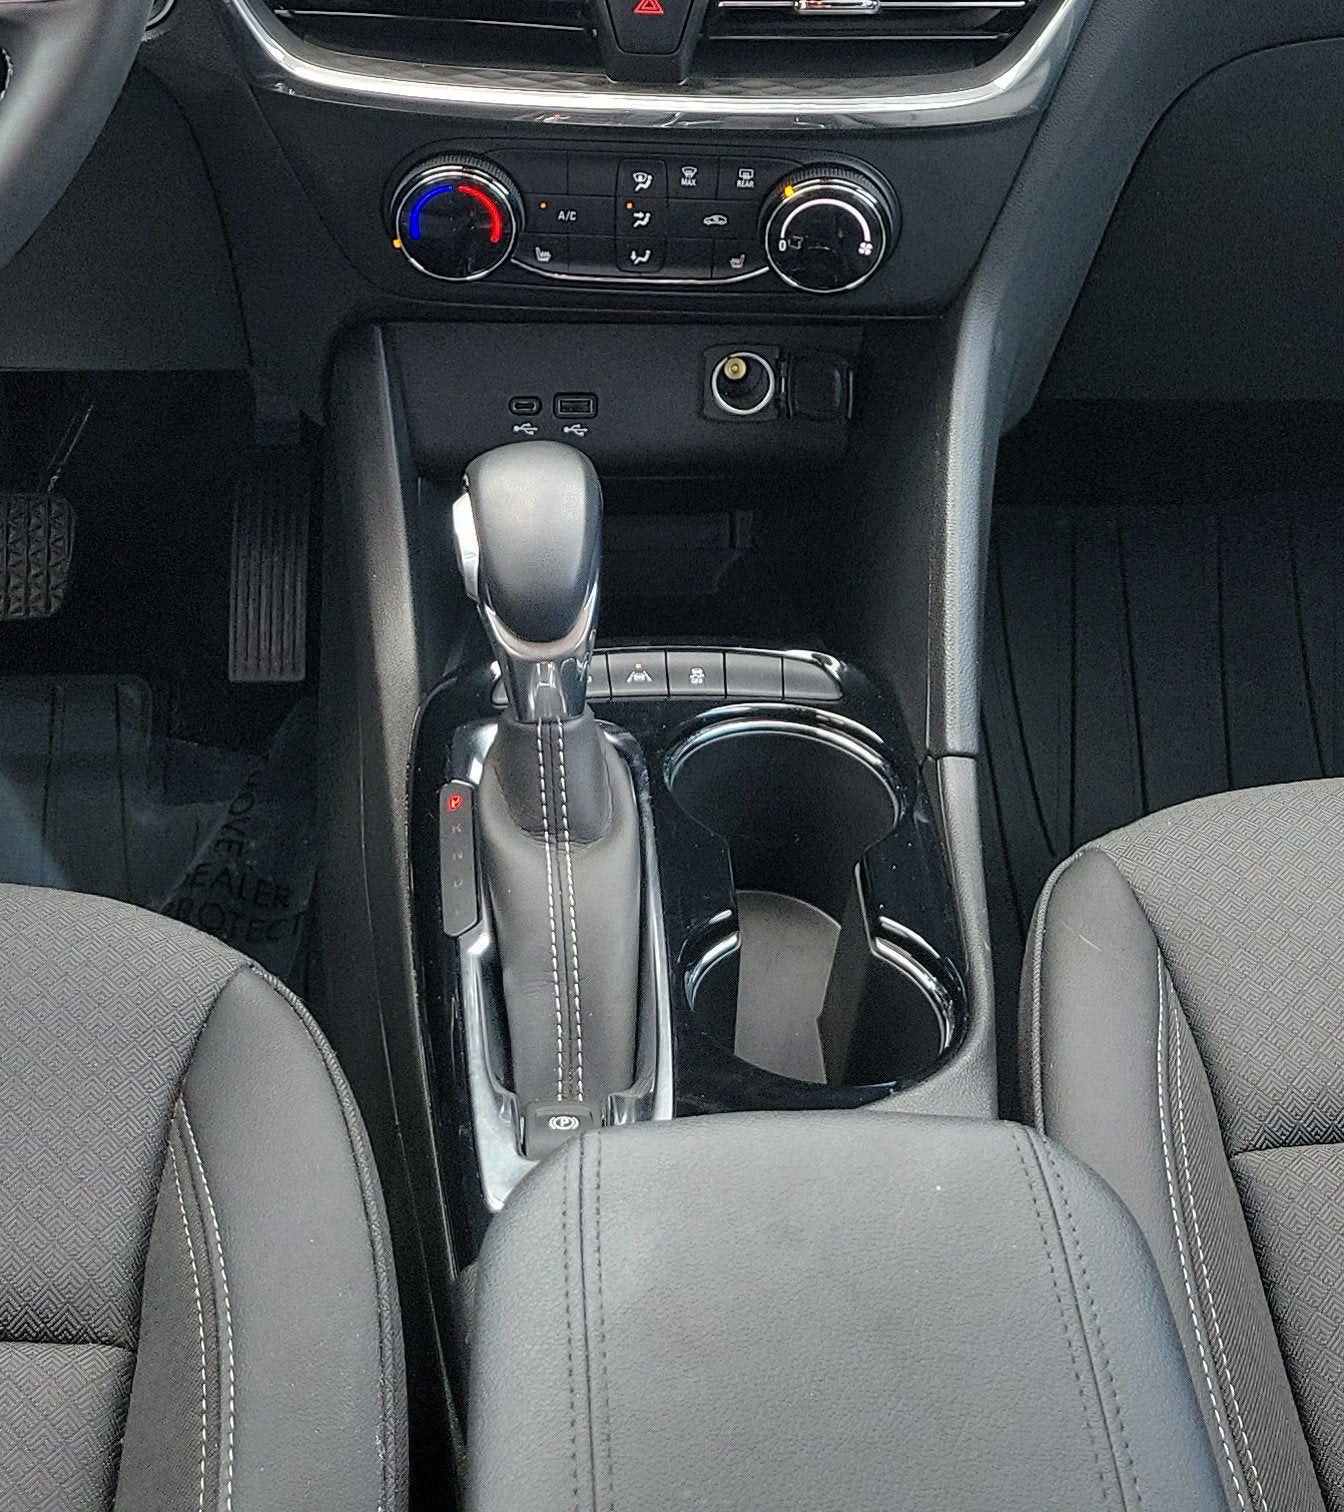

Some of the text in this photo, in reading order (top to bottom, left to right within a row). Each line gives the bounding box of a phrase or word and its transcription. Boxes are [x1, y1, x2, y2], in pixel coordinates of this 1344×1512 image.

[680, 178, 697, 187] MAX
[736, 179, 755, 188] REAR
[557, 210, 577, 222] A/C
[188, 862, 292, 909] EALER
